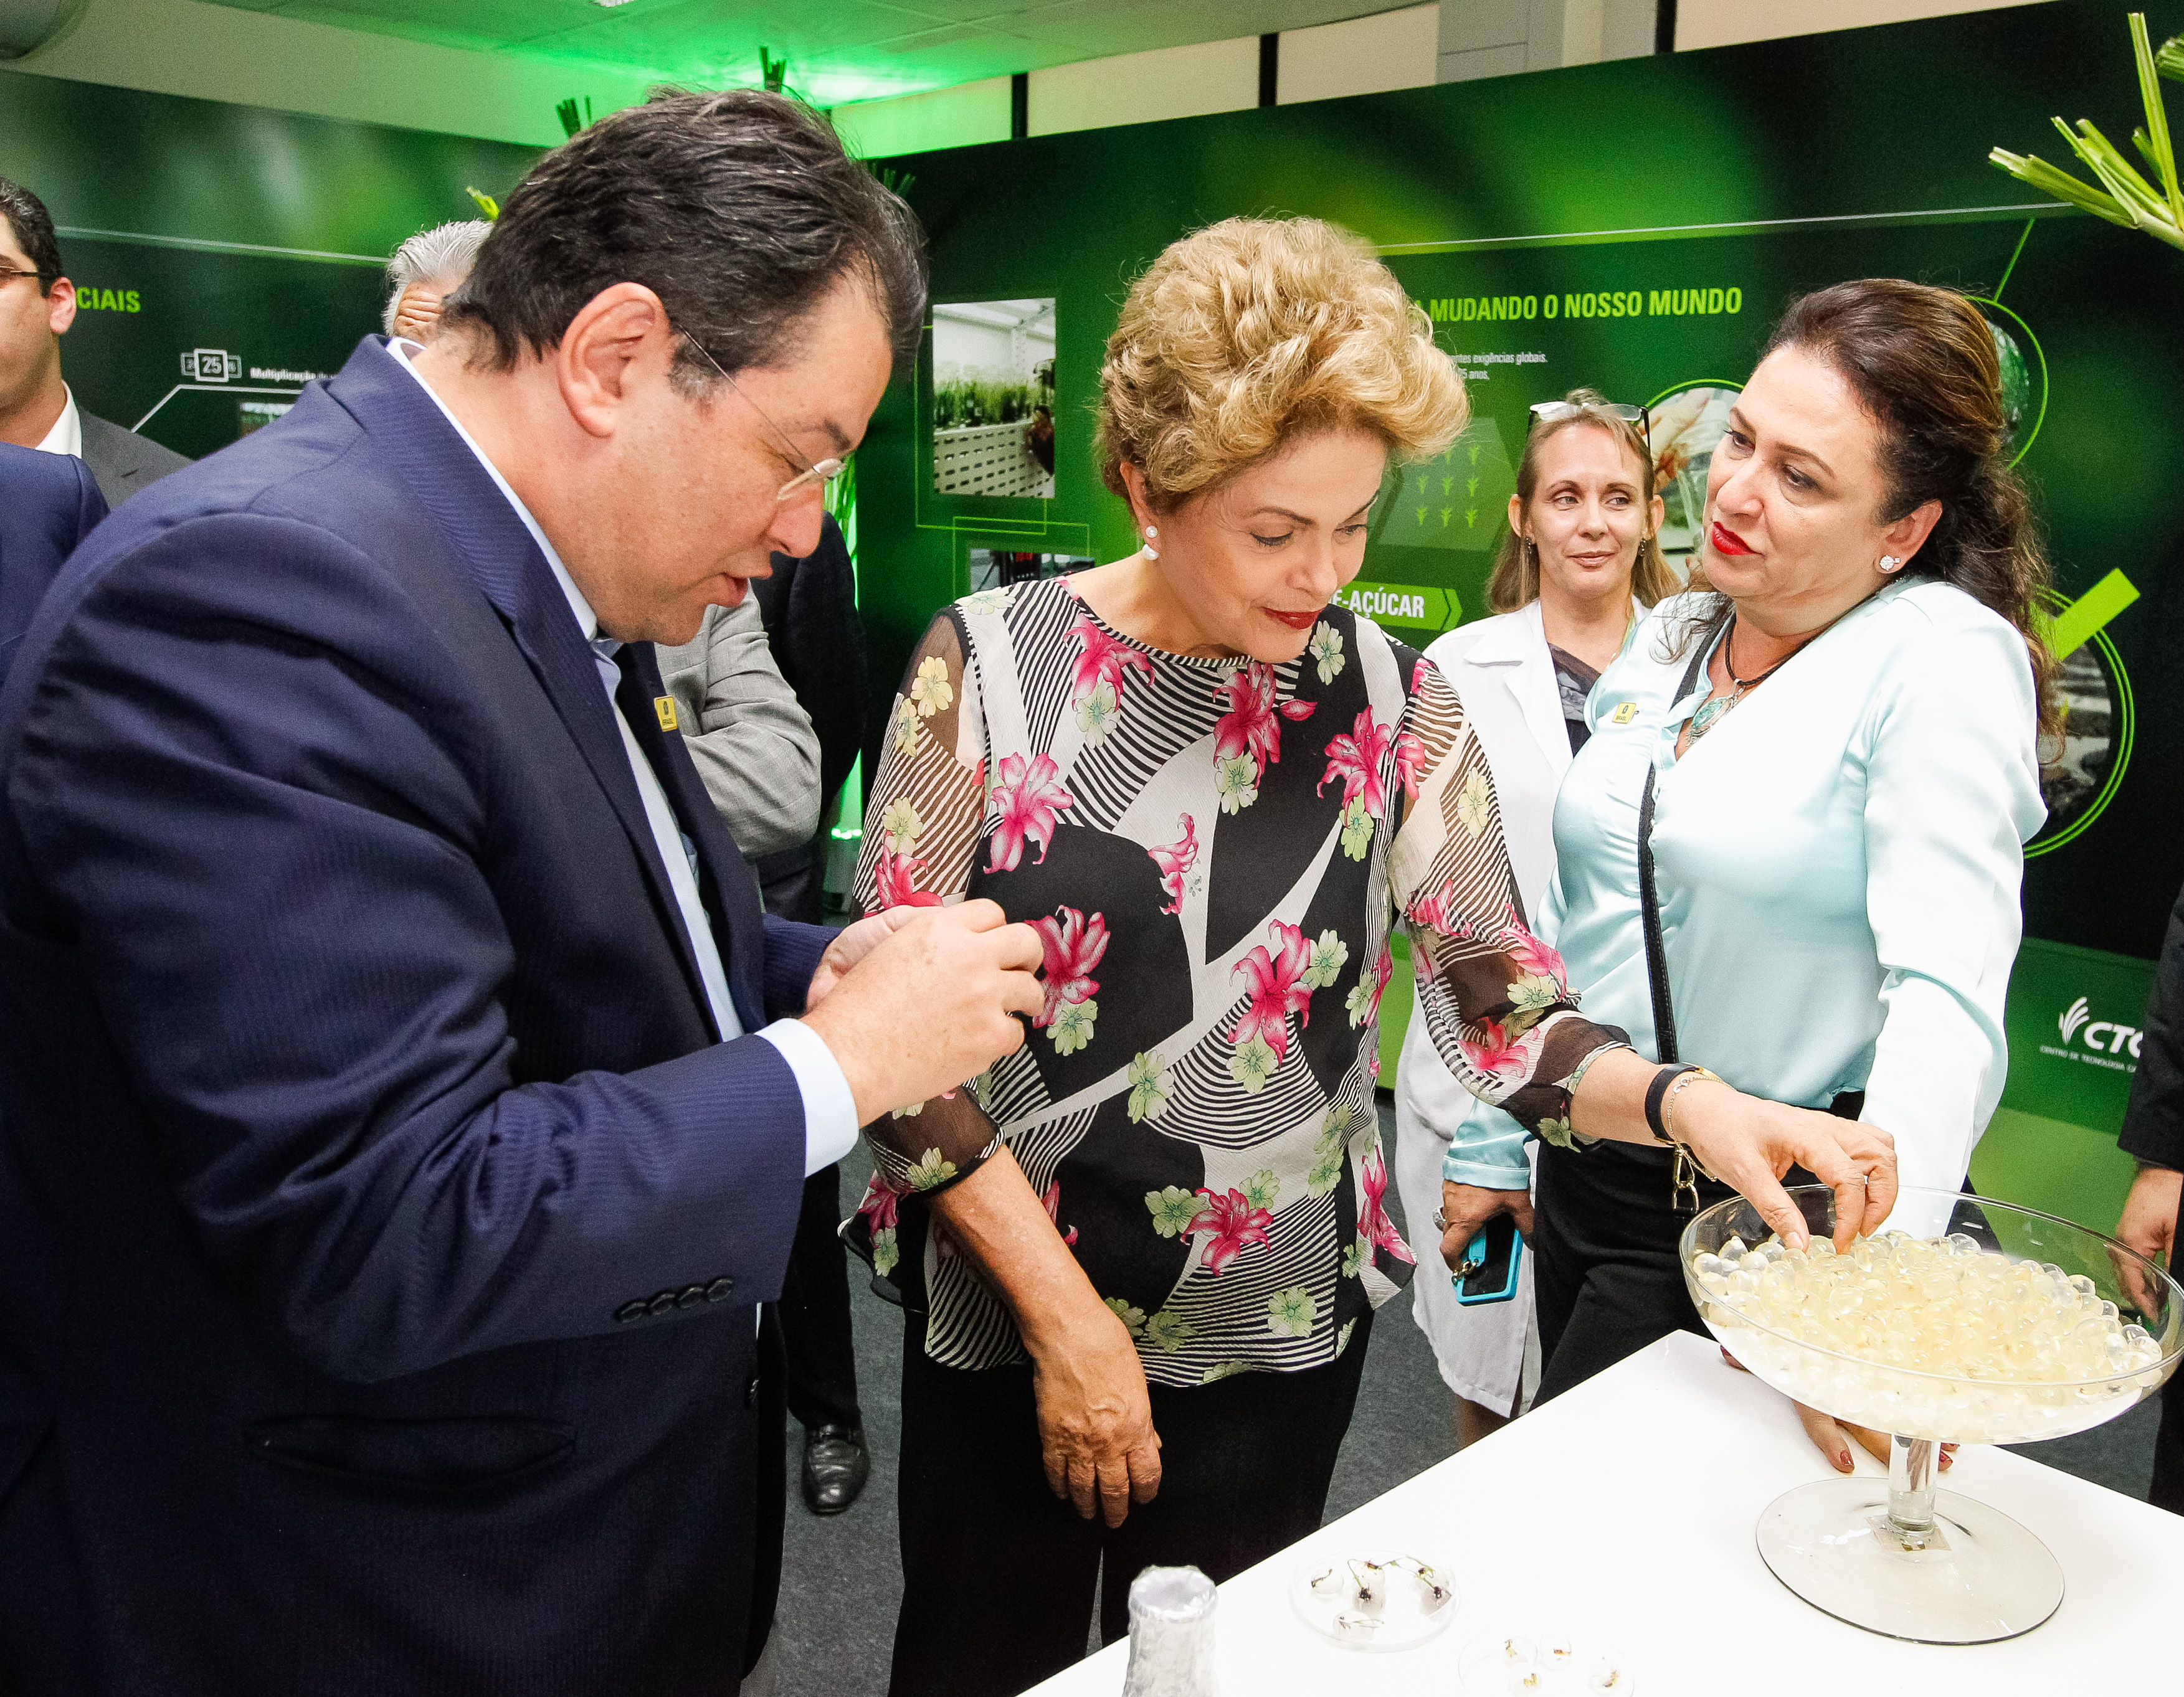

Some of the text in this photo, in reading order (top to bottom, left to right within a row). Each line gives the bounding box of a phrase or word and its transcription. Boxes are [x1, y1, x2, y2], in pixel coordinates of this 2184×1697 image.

[76, 287, 141, 313] CIAIS
[1430, 287, 1742, 322] MUDANDO O NOSSO MUNDO
[201, 356, 223, 374] 25
[1473, 351, 1514, 366] exigências
[1516, 351, 1547, 366] globais.
[1328, 586, 1425, 619] E-AÇÚCAR
